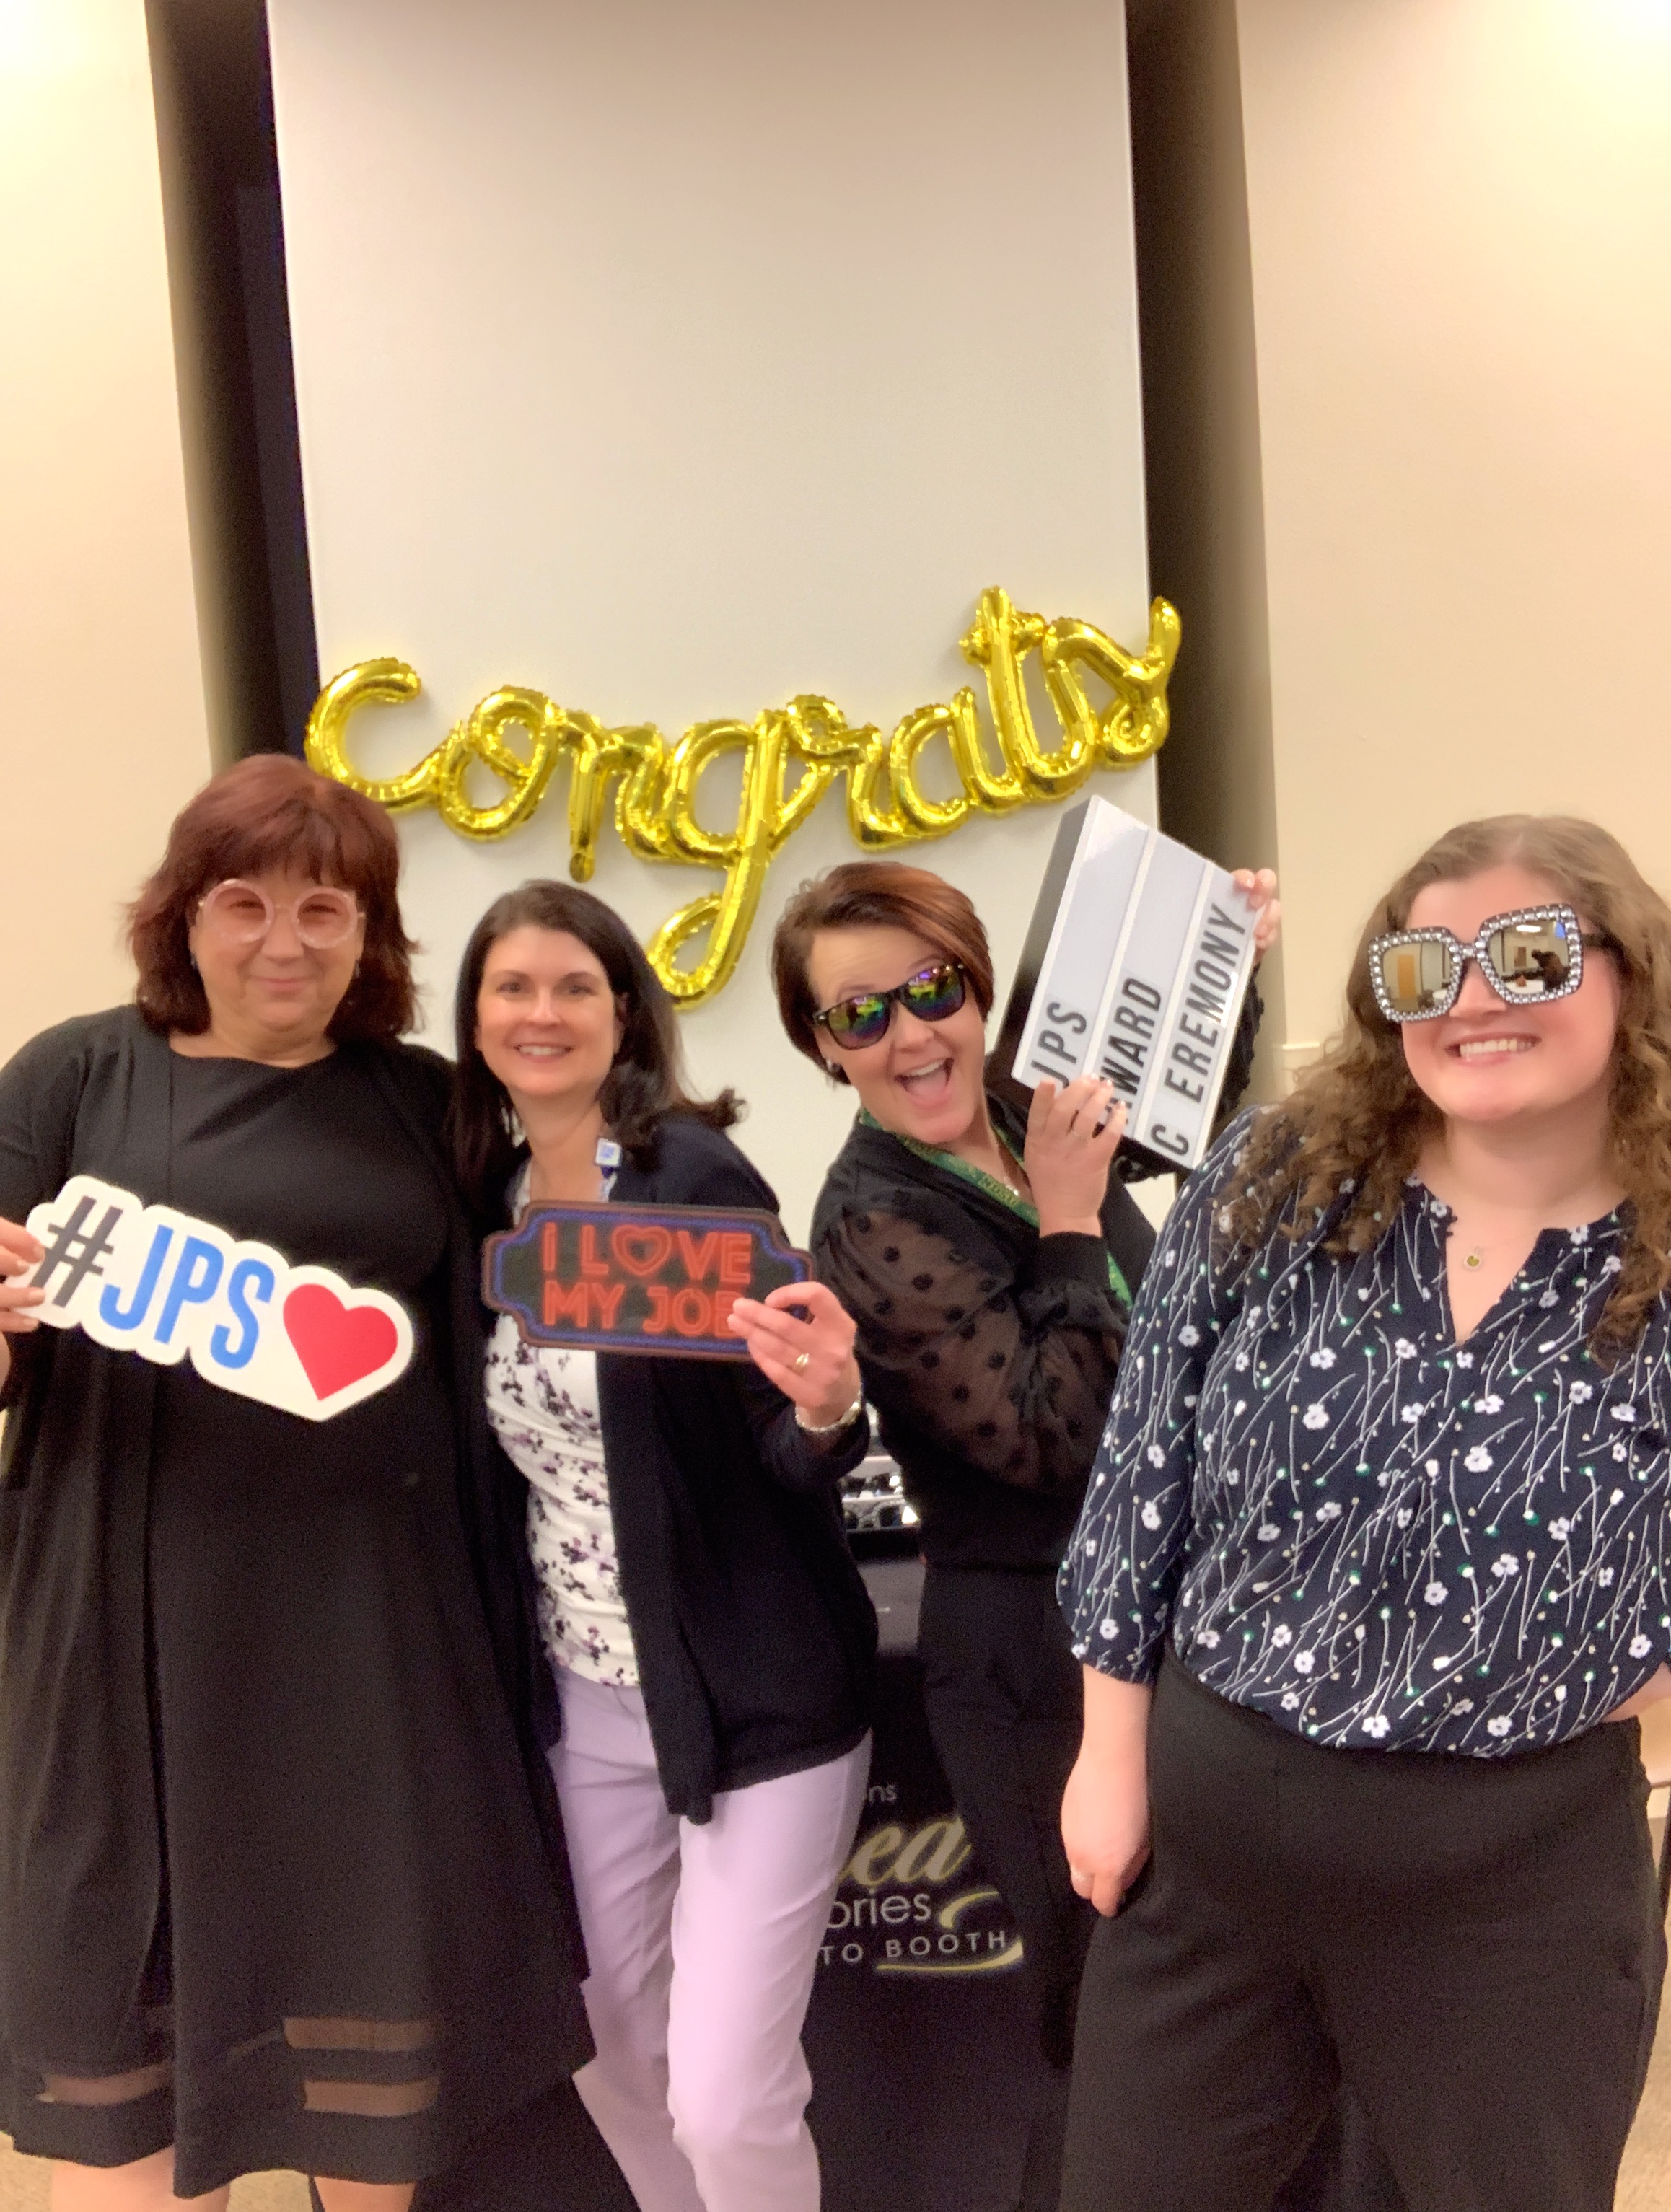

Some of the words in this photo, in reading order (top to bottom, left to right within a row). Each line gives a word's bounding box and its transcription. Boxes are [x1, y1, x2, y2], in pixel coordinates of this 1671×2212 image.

[1030, 1001, 1088, 1089] JPS
[540, 1221, 558, 1273] I
[29, 1195, 276, 1369] #JPS
[543, 1278, 626, 1330] MY
[868, 1784, 898, 1805] ns
[838, 1815, 972, 1887] ea
[826, 1888, 931, 1929] ories
[819, 1943, 864, 1965] TO
[885, 1930, 1006, 1959] BOOTH
